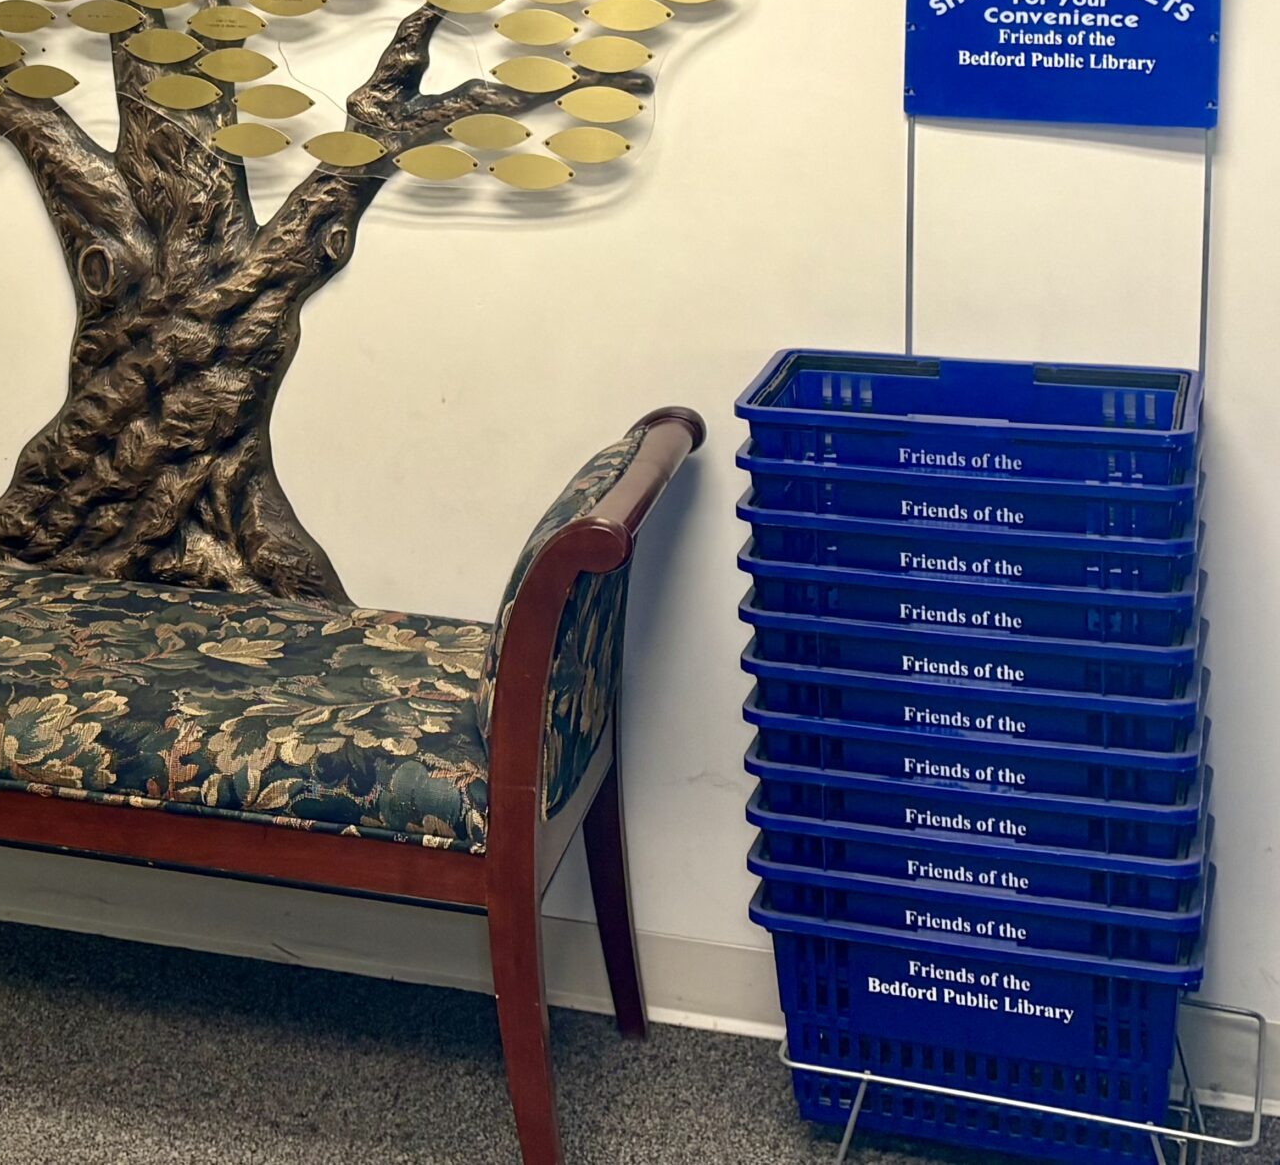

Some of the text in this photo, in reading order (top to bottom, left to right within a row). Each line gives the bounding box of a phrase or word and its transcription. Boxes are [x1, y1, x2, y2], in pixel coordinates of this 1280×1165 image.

[983, 6, 1139, 28] Convenience
[998, 28, 1116, 47] Friends of the
[958, 50, 1156, 74] Bedford Public Library
[899, 448, 1022, 470] Friends of the
[900, 500, 1023, 524] Friends of the
[899, 552, 1022, 576] Friends of the
[899, 603, 1022, 628] Friends of the
[901, 655, 1024, 681] Friends of the
[903, 706, 1025, 733] Friends of the
[903, 757, 1025, 785] Friends of the
[904, 808, 1026, 836] Friends of the
[906, 860, 1028, 889] Friends of the
[904, 910, 1026, 940] Friends of the
[908, 960, 1030, 992] Friends of the
[867, 976, 1074, 1024] Bedford Public Library
